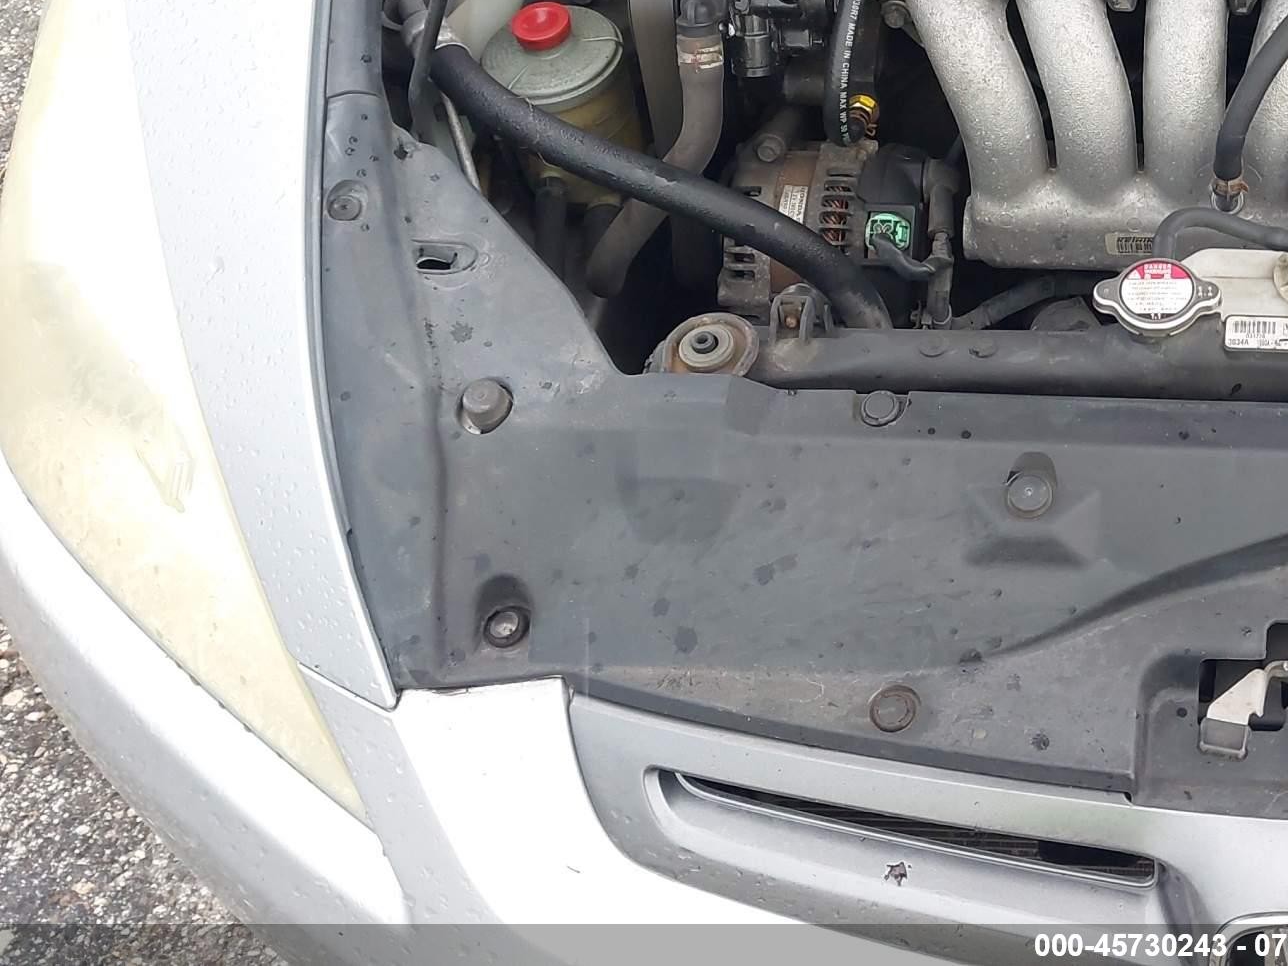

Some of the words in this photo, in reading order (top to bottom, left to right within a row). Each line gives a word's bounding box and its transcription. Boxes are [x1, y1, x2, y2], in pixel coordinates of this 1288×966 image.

[845, 22, 856, 47] MADE
[843, 50, 851, 59] IN
[839, 62, 850, 89] CHINA
[839, 91, 848, 109] MAX
[839, 111, 848, 123] WP
